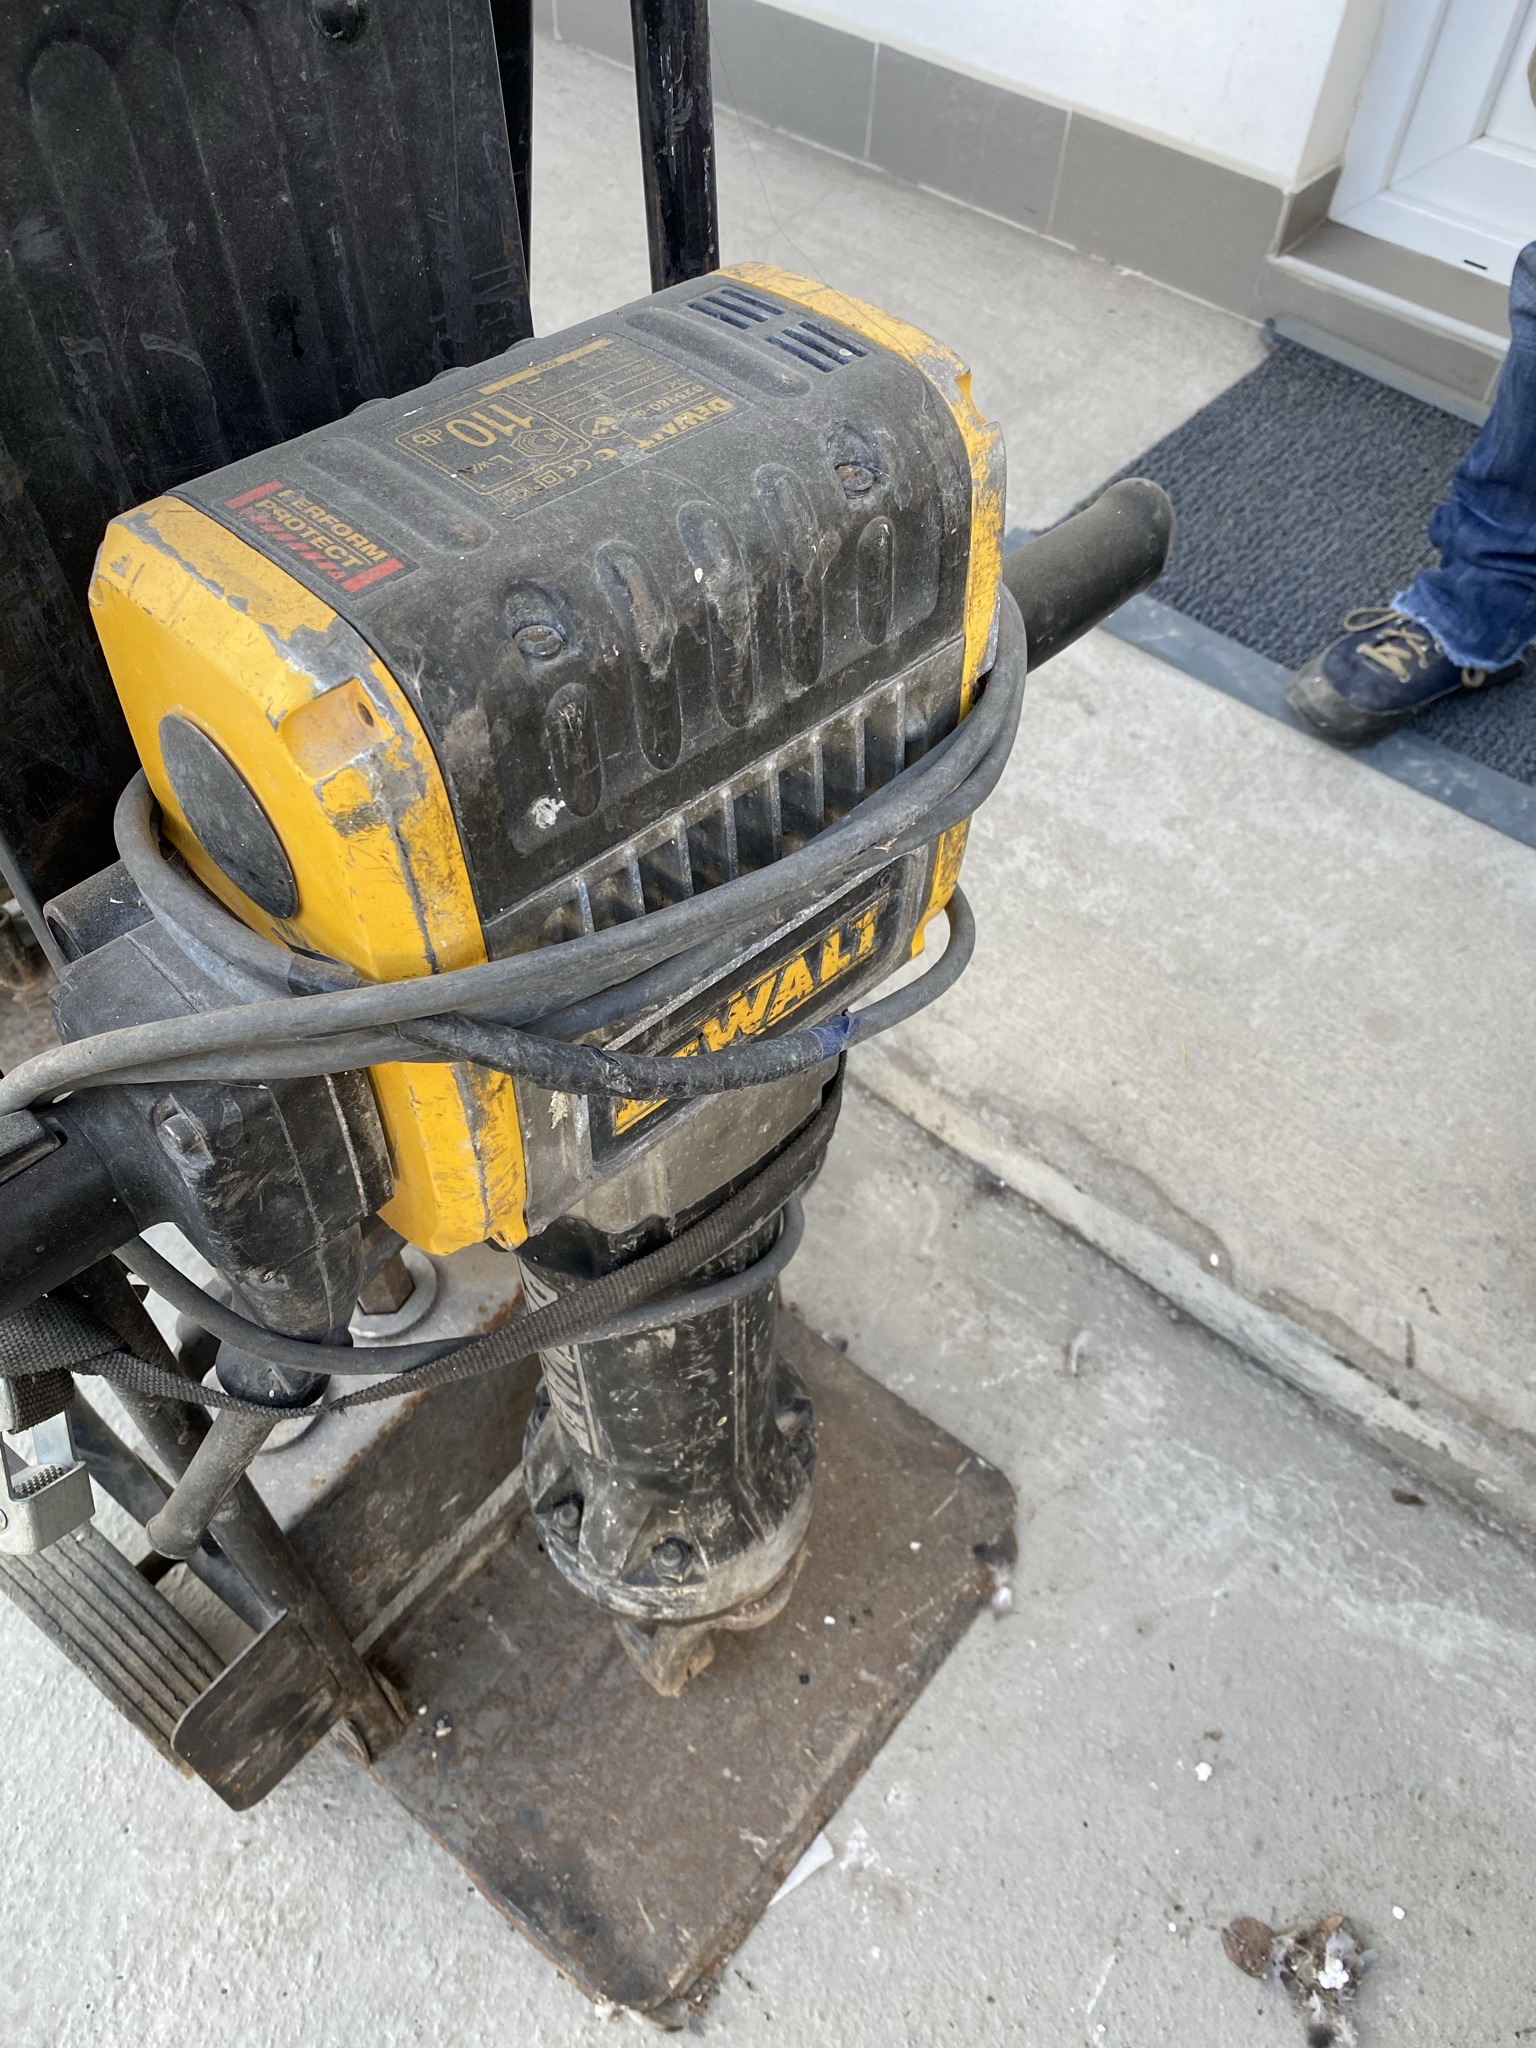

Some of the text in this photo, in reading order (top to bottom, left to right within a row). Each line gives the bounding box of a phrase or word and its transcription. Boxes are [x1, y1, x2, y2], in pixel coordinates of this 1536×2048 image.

[411, 428, 443, 447] dB
[445, 403, 536, 447] 110
[255, 499, 365, 568] PROTECT
[614, 900, 880, 1128] WALT
